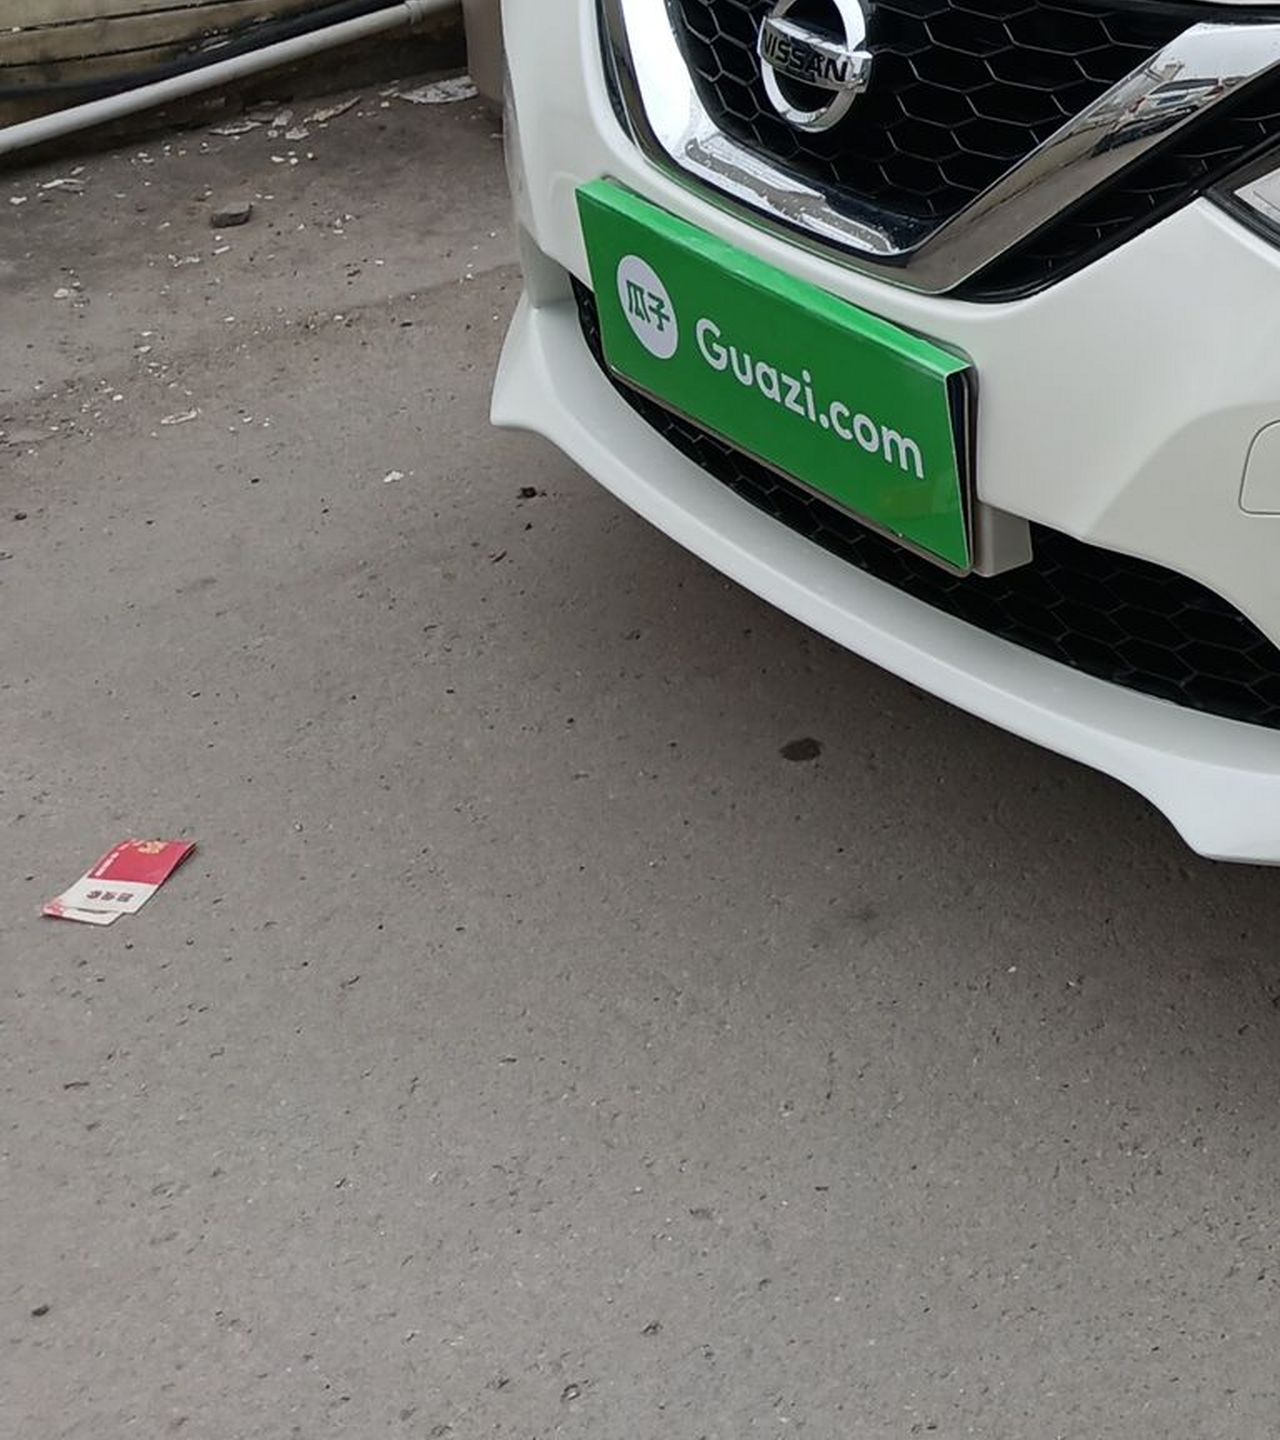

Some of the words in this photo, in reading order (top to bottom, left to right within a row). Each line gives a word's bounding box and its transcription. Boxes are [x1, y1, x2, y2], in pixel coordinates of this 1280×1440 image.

[763, 26, 850, 83] NISSAN
[626, 279, 671, 332] 瓜子
[696, 317, 925, 480] Guazi.com
